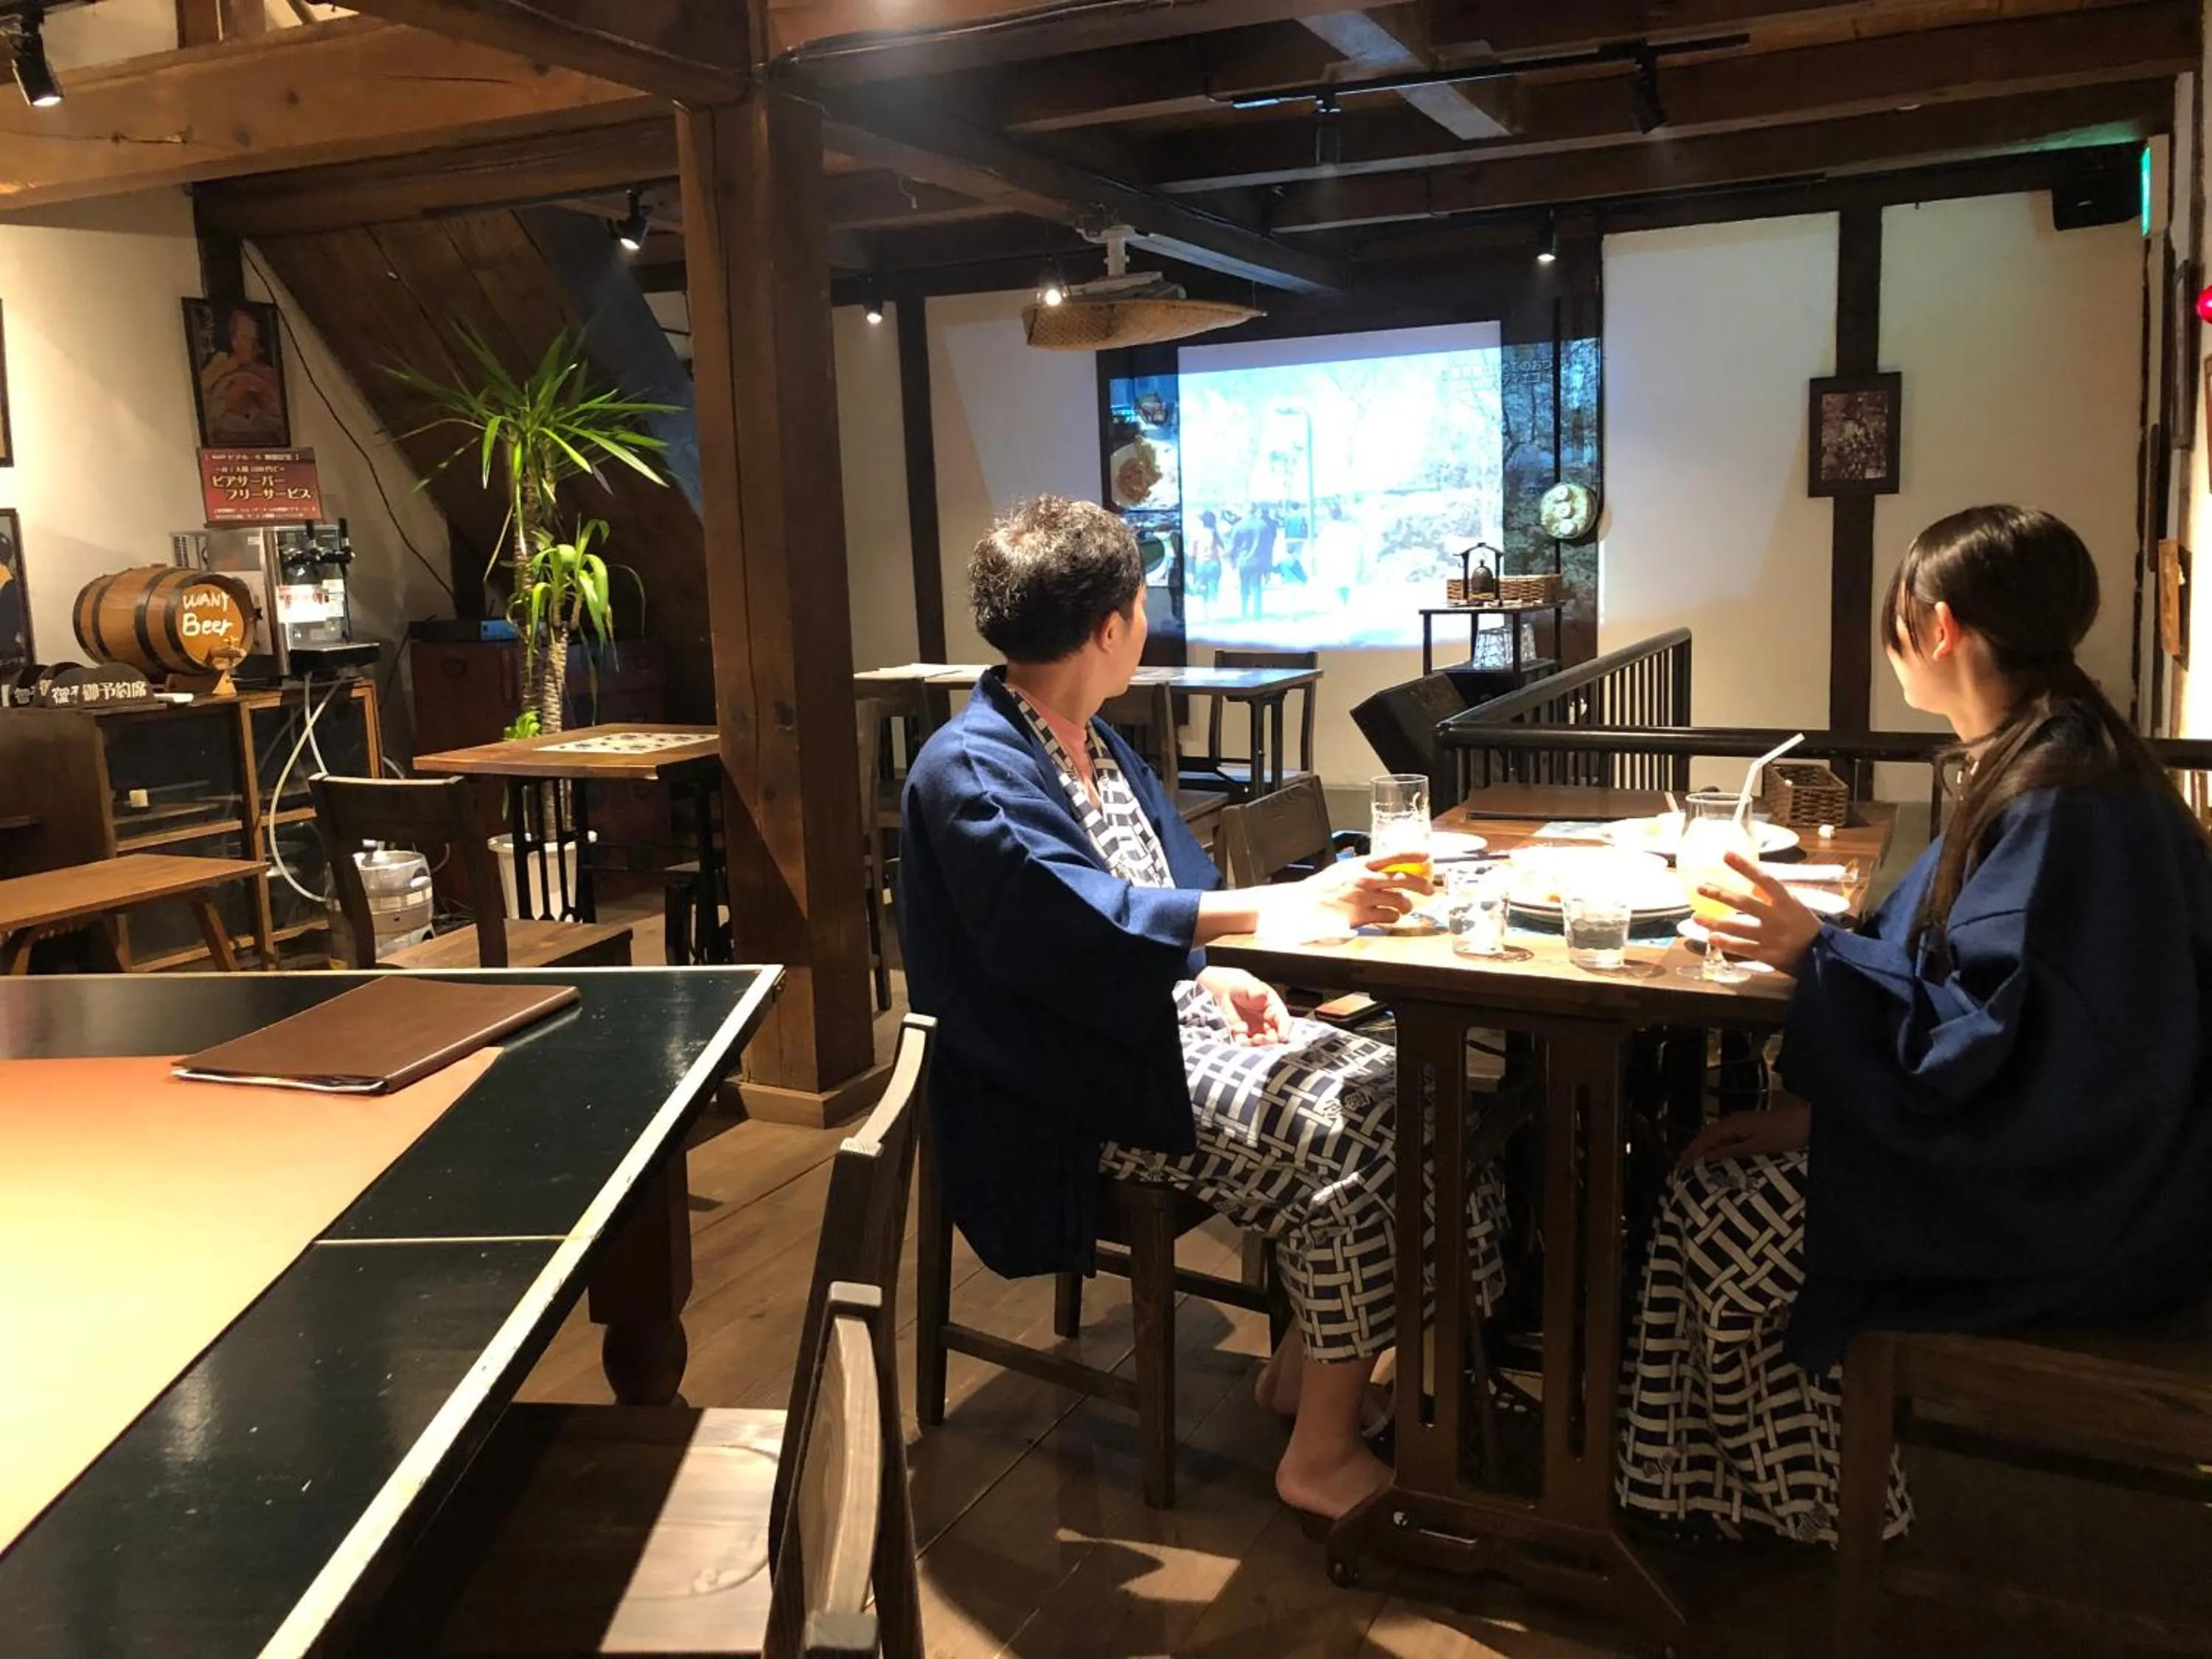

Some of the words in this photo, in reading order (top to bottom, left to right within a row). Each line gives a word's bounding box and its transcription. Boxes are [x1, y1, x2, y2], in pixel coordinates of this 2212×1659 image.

[183, 613, 234, 636] Beer
[82, 681, 147, 700] 御予約席
